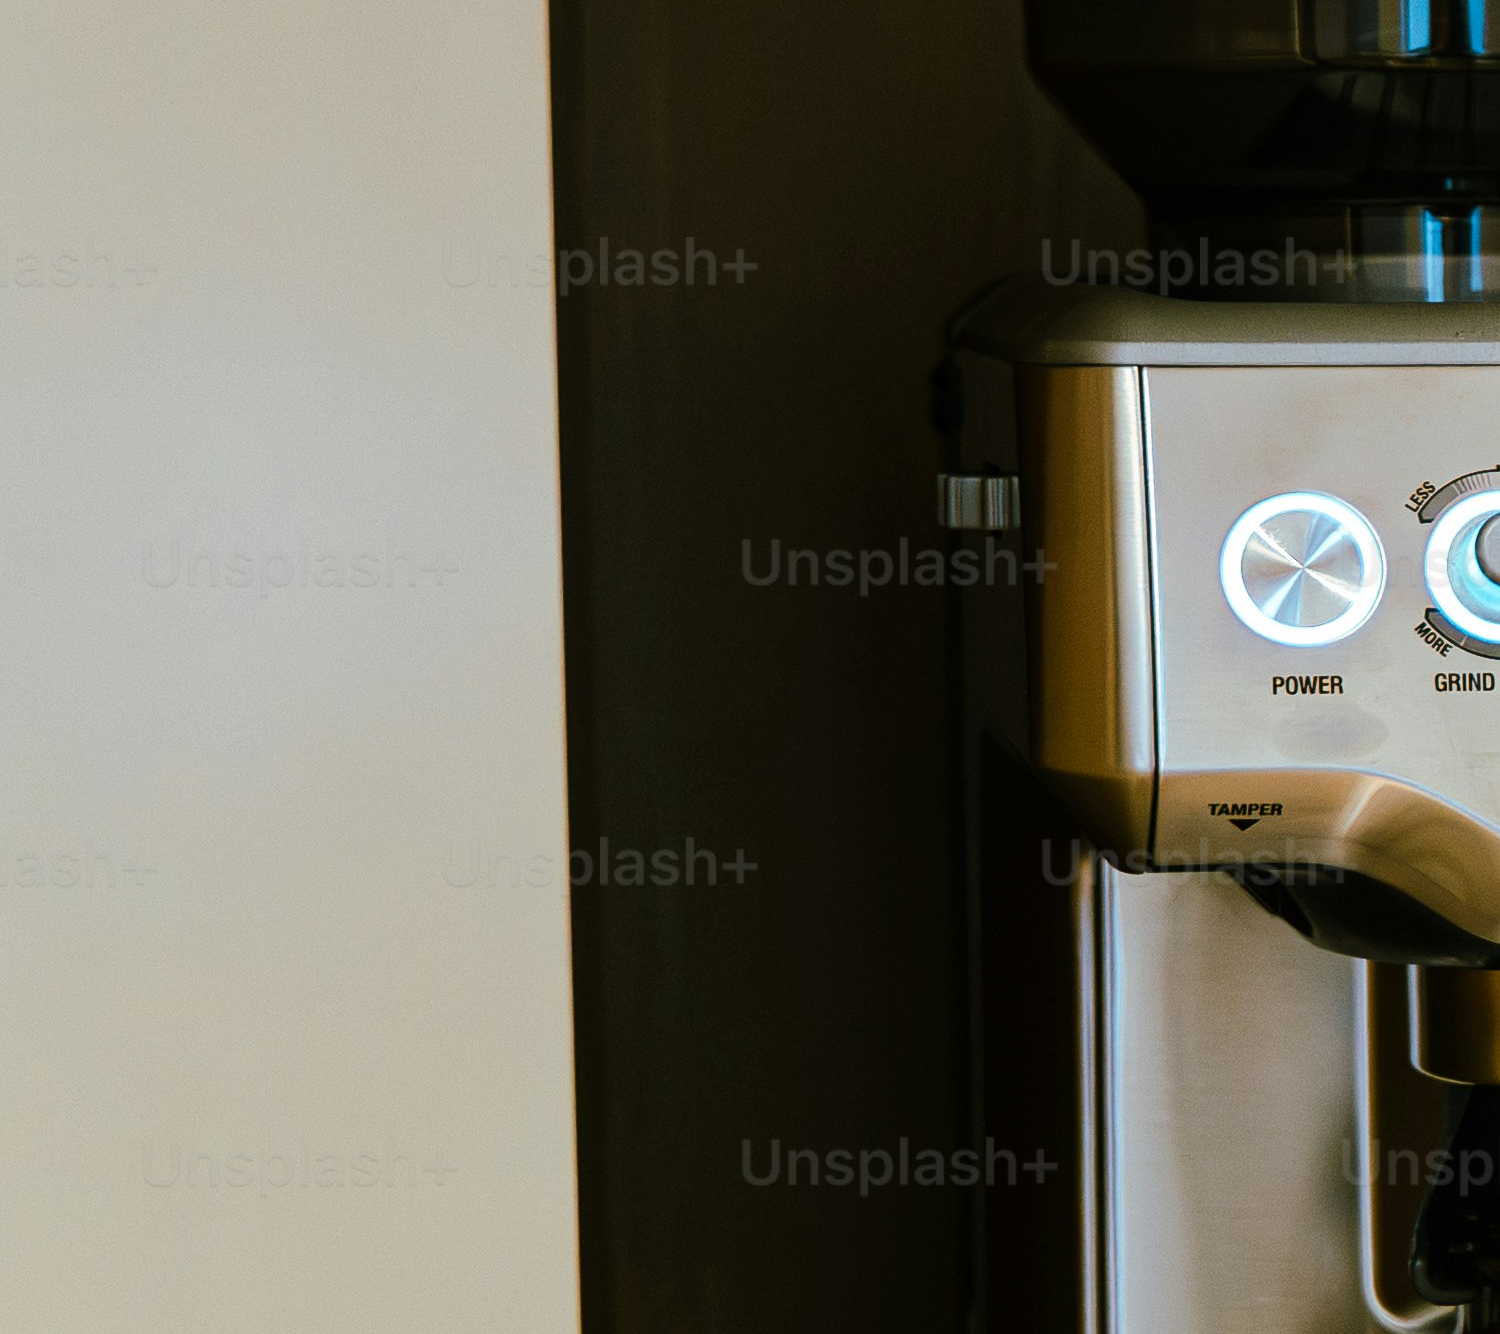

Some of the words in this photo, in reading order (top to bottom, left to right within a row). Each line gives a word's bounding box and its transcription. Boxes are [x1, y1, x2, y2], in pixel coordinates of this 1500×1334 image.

[1404, 481, 1436, 513] LESS
[1414, 621, 1453, 657] MORE
[1272, 675, 1344, 695] POWER
[1434, 672, 1495, 692] GRIND
[1208, 802, 1284, 816] TAMPER
